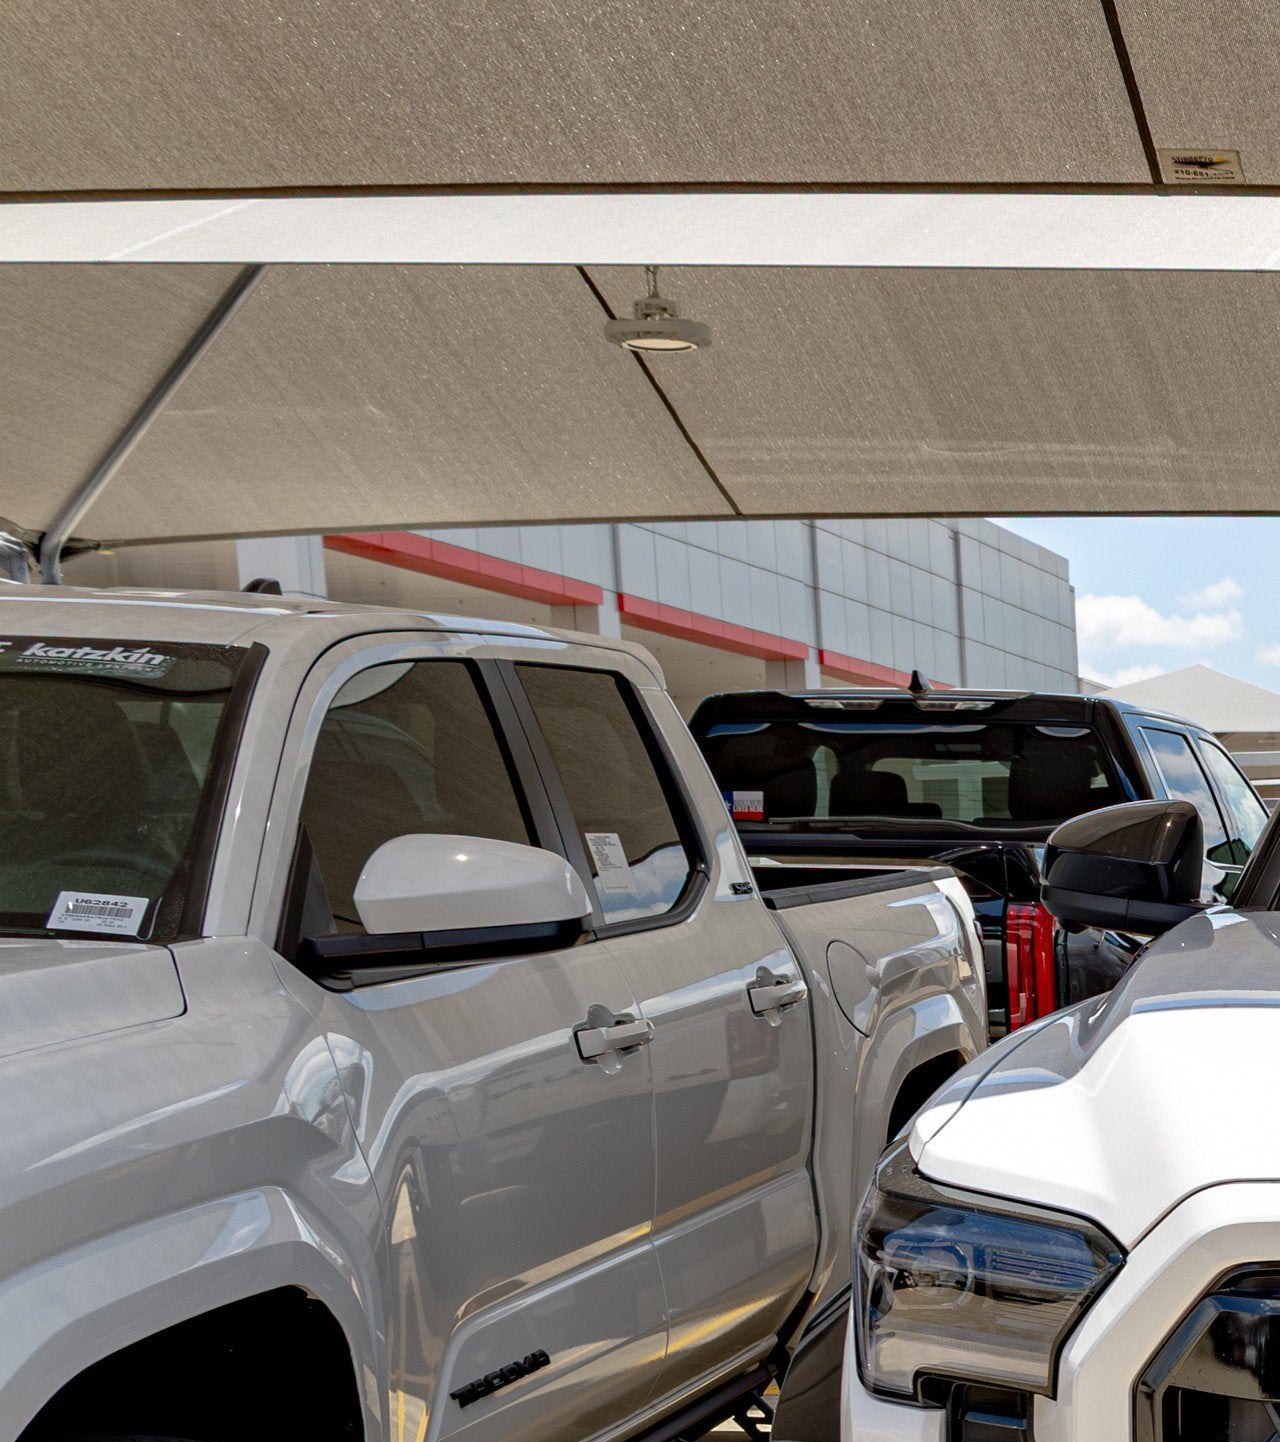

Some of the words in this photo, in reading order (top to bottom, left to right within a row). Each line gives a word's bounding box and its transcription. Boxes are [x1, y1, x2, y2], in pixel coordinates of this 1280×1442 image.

[22, 642, 166, 665] katzkin
[75, 898, 128, 908] U62842
[450, 1348, 551, 1409] TACOMA
